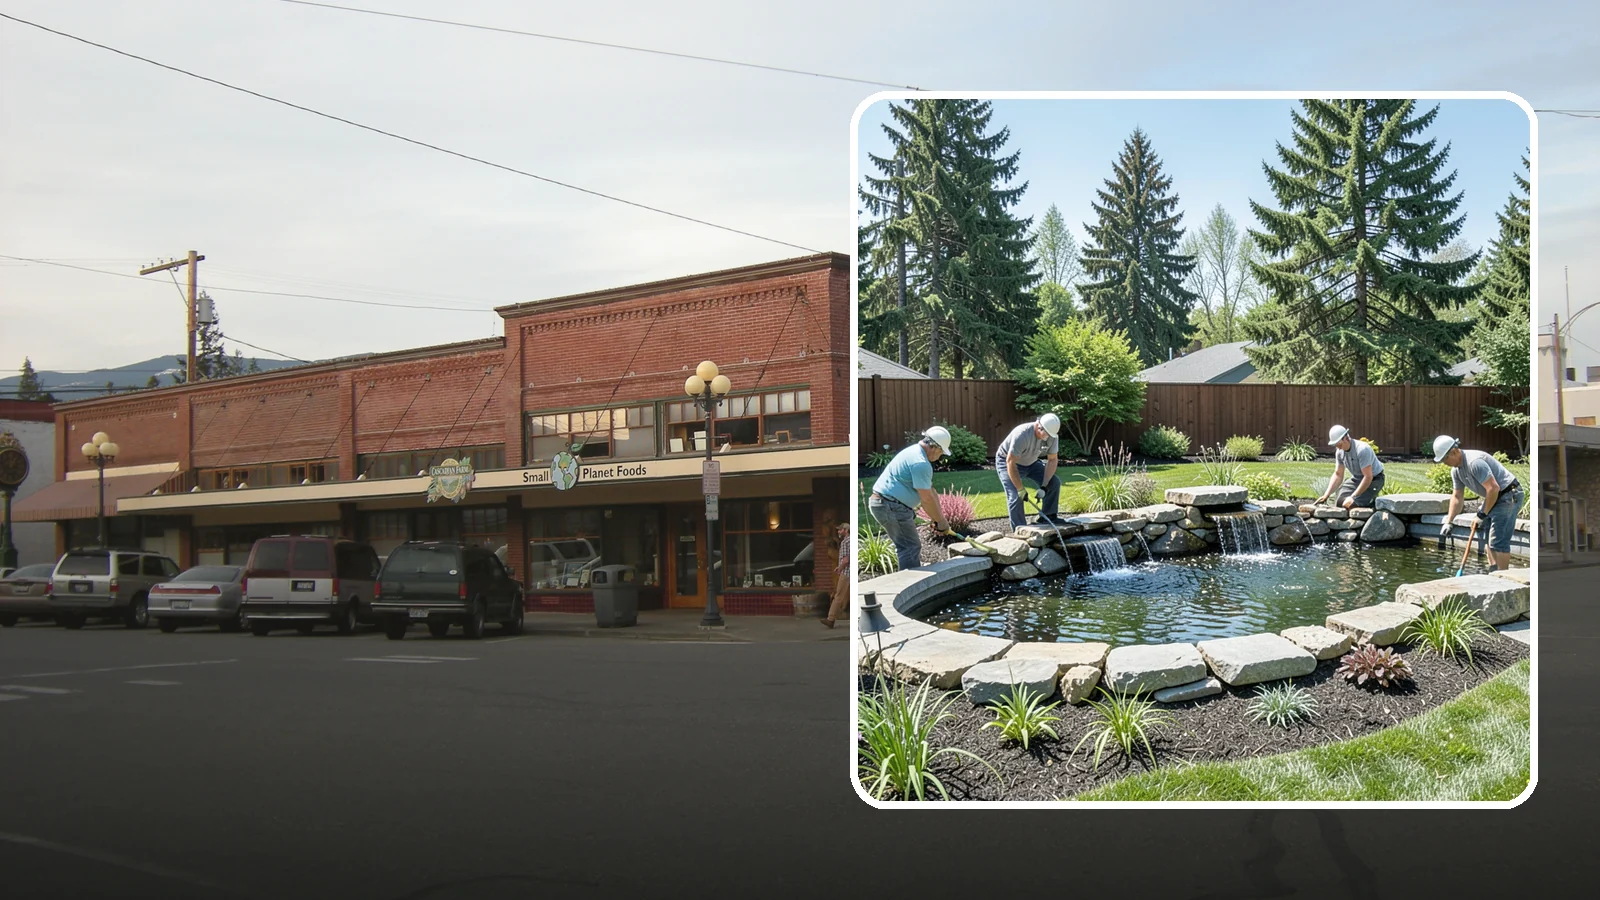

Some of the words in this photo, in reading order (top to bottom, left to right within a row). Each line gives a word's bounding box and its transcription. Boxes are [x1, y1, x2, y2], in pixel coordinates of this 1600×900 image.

[523, 471, 549, 483] Small
[583, 467, 614, 479] Planet
[617, 464, 647, 477] Foods
